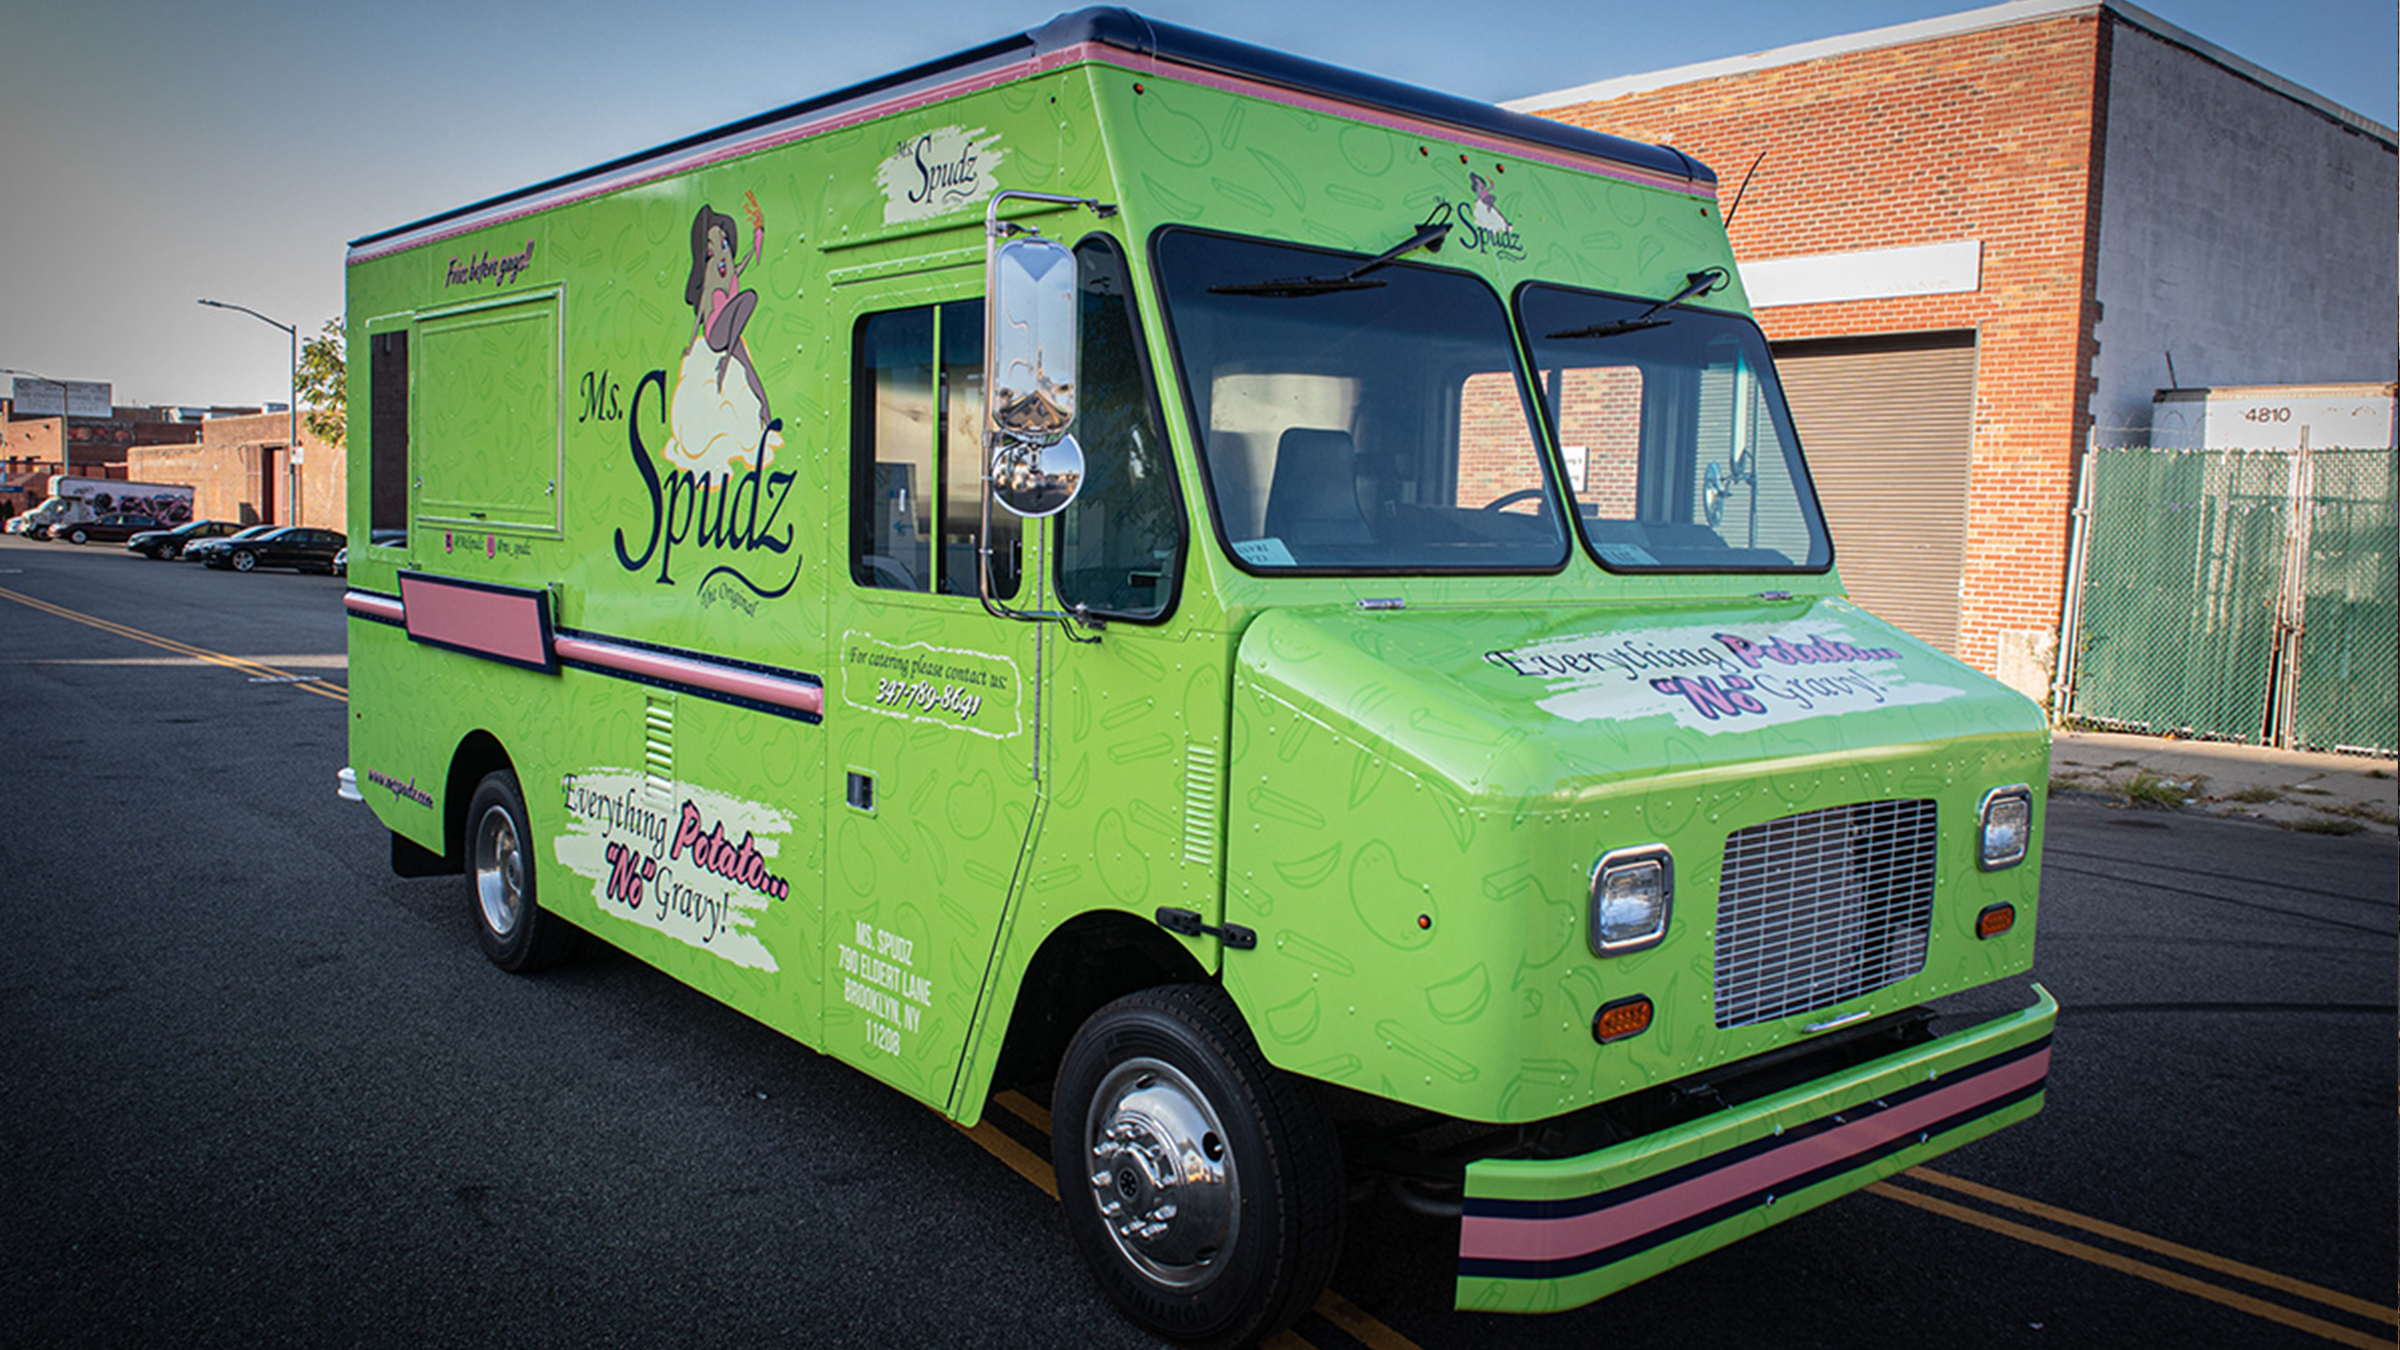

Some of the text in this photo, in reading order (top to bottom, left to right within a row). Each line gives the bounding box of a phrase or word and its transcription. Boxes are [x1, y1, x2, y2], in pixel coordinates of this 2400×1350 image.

[908, 132, 977, 204] Spudz
[1459, 201, 1524, 254] Spudz
[579, 369, 623, 423] Ms.
[2245, 407, 2291, 423] 4810
[613, 369, 798, 586] Spudz
[850, 646, 868, 664] For
[868, 652, 909, 678] catering
[910, 654, 943, 680] please
[945, 665, 987, 686] contact
[1484, 639, 1742, 681] Everything
[875, 677, 982, 720] 347-789-8641
[1753, 668, 1888, 710] Gravy!
[562, 773, 790, 902] Everything Potato...
[655, 866, 730, 943] Gravy!
[856, 920, 913, 967] MS. SPUDZ
[838, 943, 932, 1007] 790 ELDERT LANE
[866, 1018, 901, 1056] 11208
[904, 1004, 921, 1033] NY
